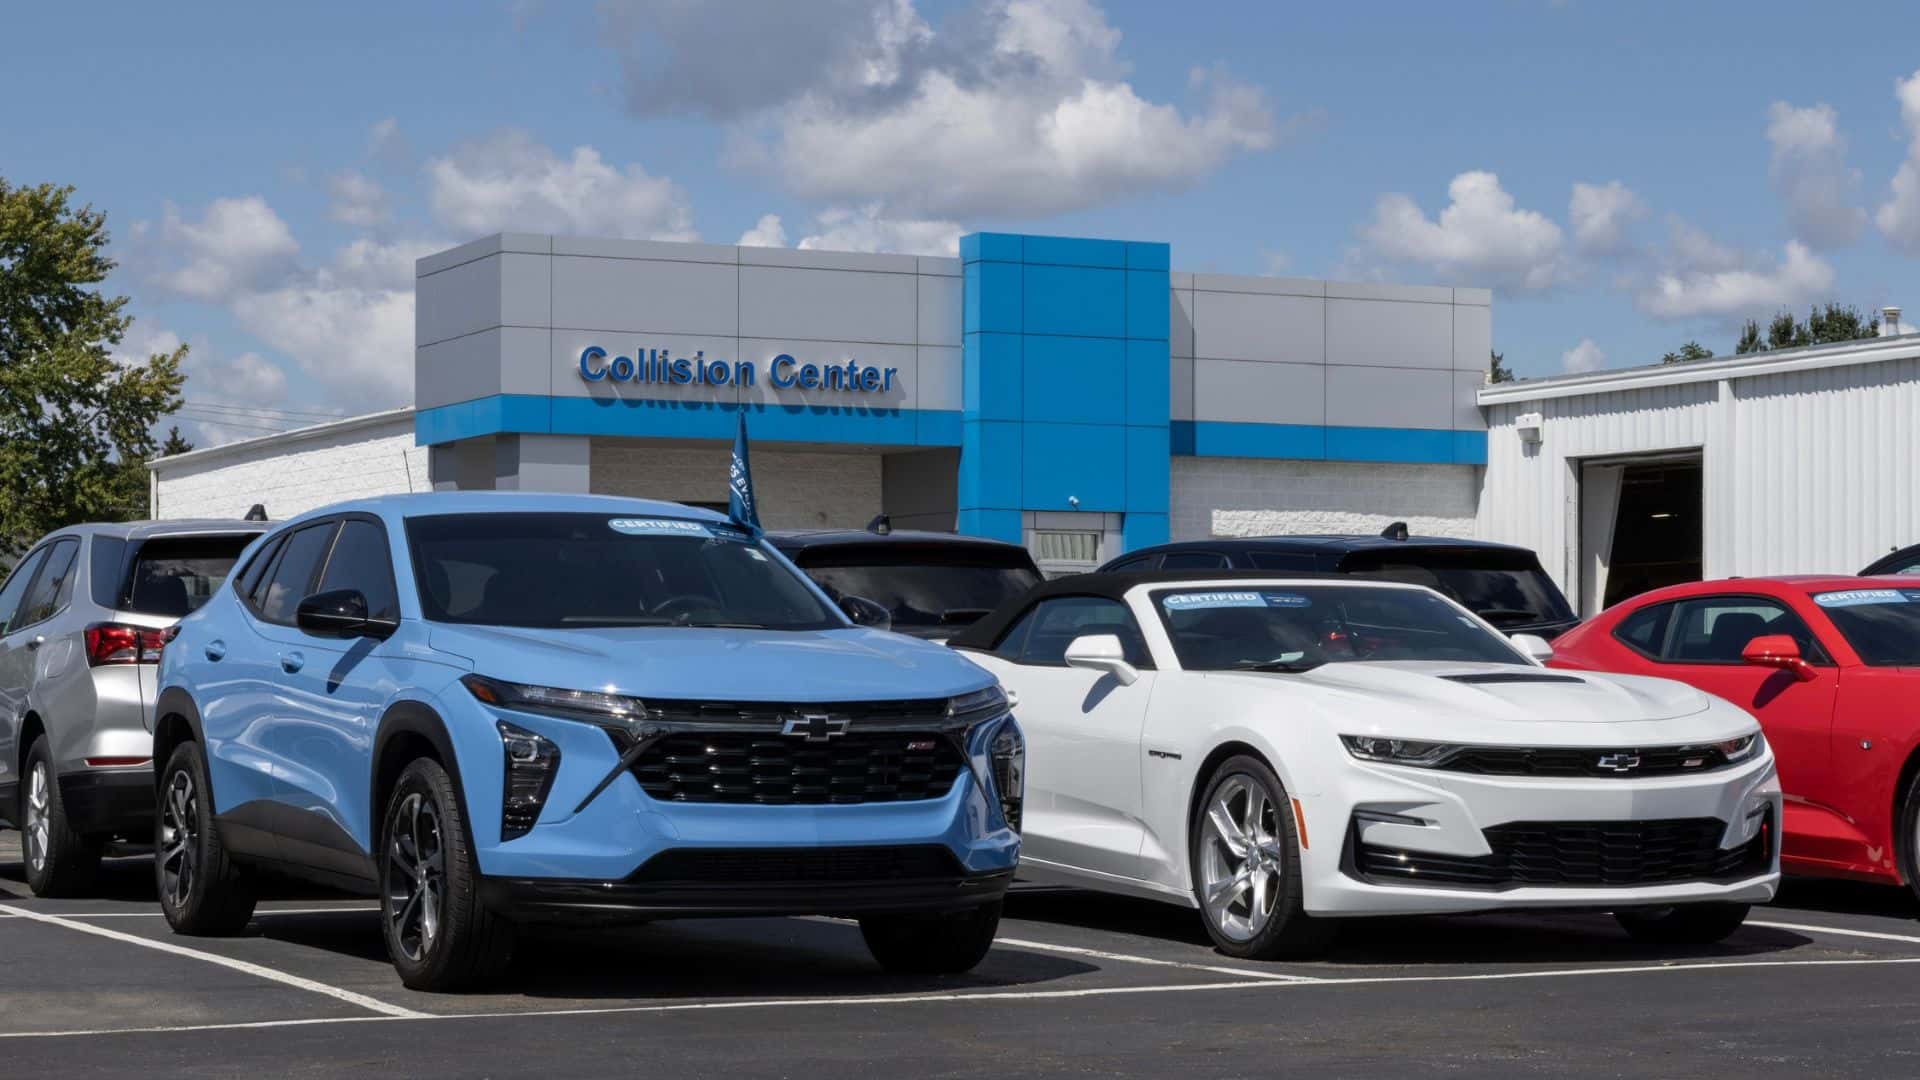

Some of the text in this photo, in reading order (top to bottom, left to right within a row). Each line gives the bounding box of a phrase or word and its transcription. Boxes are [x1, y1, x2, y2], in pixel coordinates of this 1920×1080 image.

[580, 346, 897, 391] Collision Center
[612, 518, 701, 531] CERTIFIED
[1168, 592, 1257, 604] CERTIFIED
[1818, 590, 1897, 602] CERTIFIED
